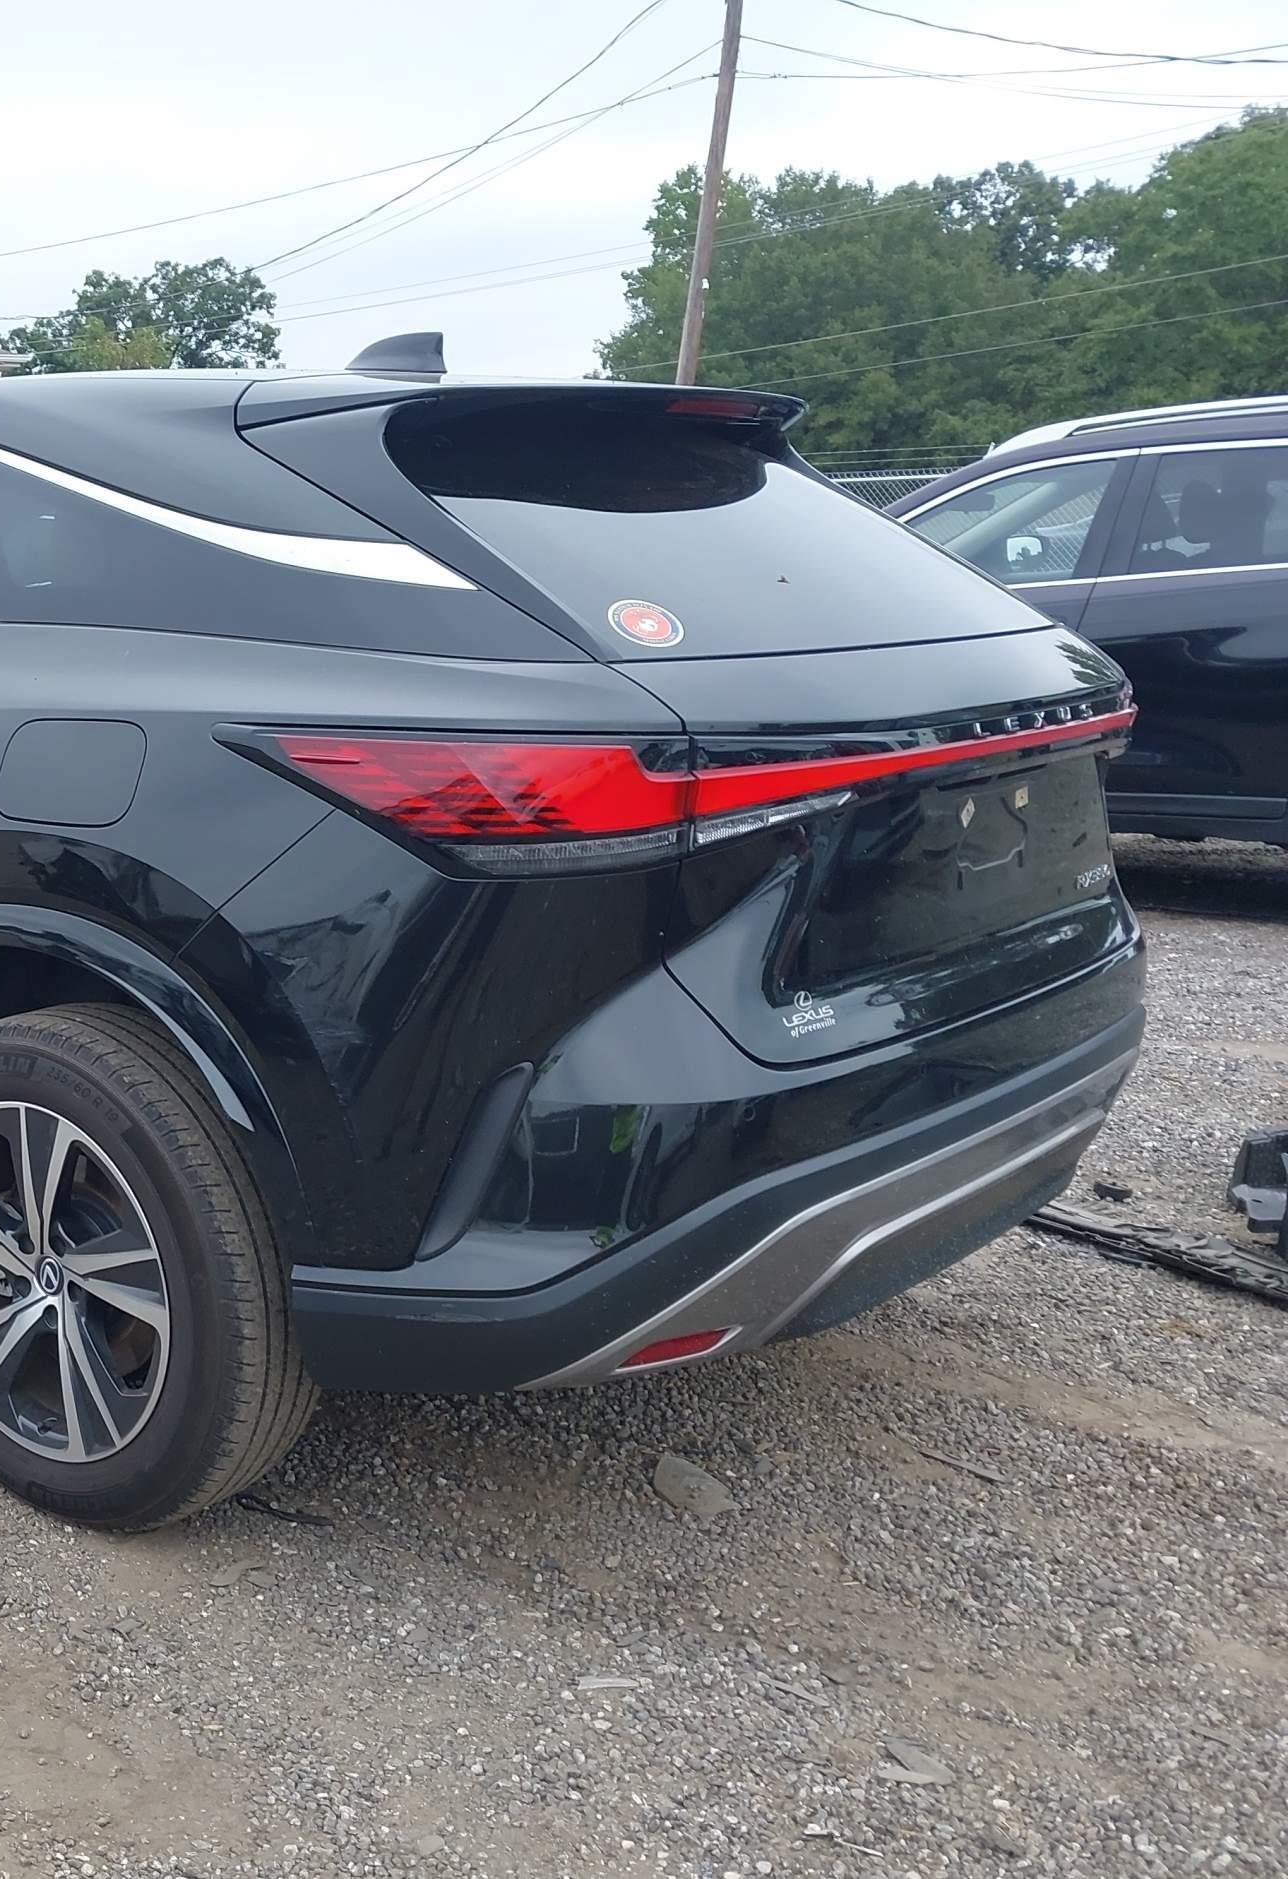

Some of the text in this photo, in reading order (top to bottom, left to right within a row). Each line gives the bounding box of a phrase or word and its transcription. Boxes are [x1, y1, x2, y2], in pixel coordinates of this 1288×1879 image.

[973, 703, 1094, 737] LEXUS
[782, 1005, 834, 1027] LEXUS
[791, 1018, 836, 1038] of Greenville
